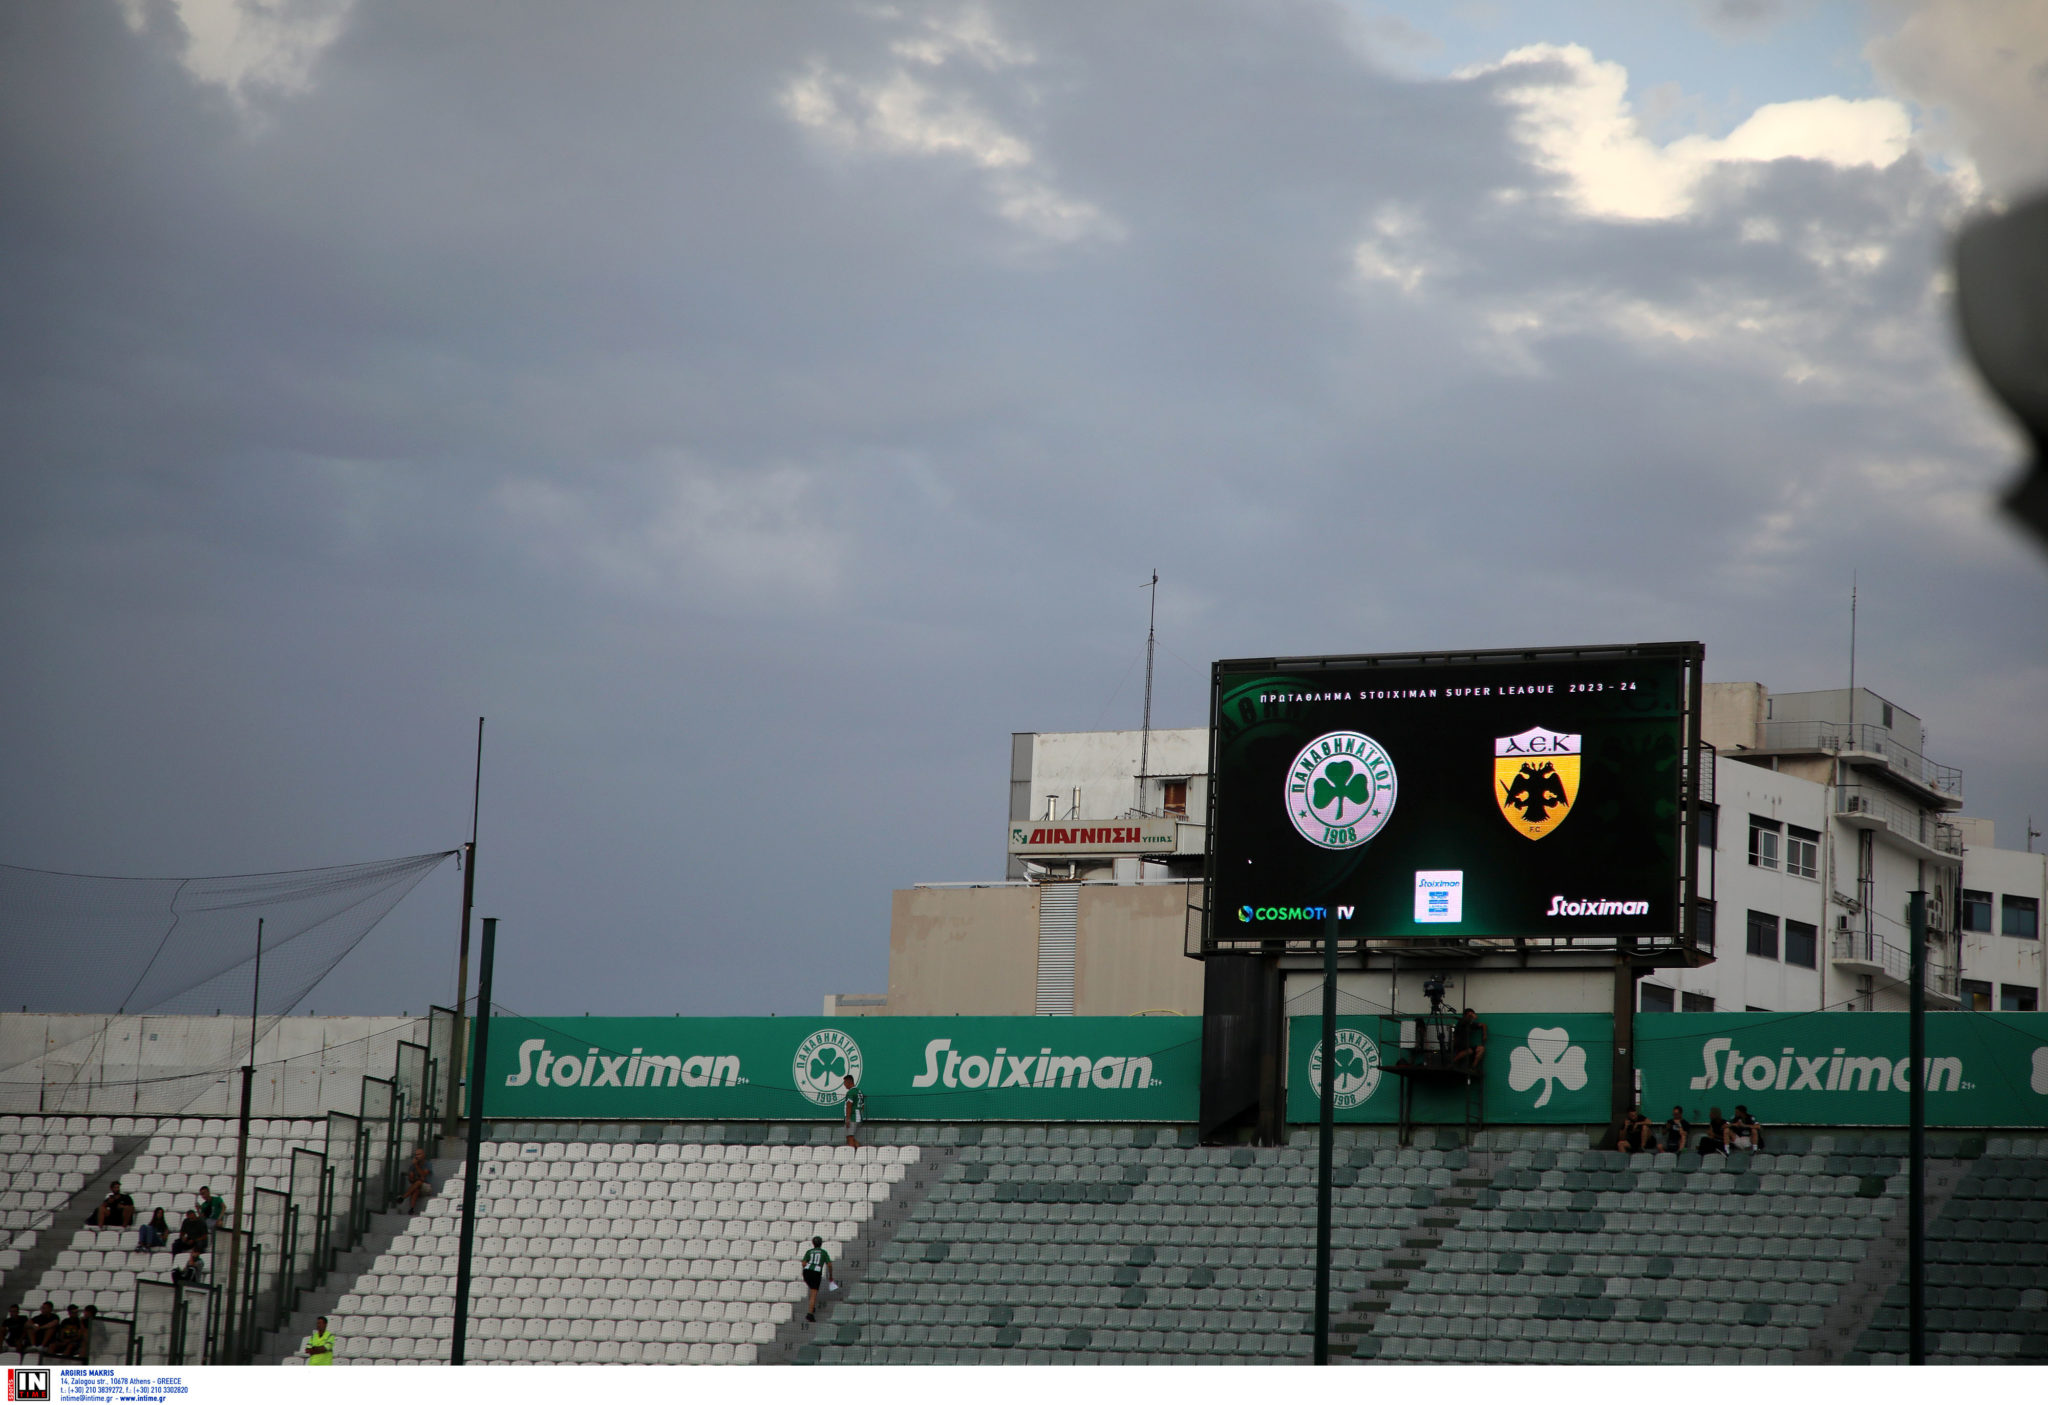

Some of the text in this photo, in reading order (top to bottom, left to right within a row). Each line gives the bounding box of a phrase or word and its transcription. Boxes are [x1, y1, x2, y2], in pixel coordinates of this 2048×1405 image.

[1260, 692, 1352, 703] ΠΡΩΤΑΘΛΗΜΑ
[1360, 689, 1437, 700] STOIXIMAN
[1445, 686, 1491, 697] SUPER
[1498, 684, 1554, 696] LEAGUE
[1029, 827, 1141, 845] ΔΙΑΓΝΩΣΗ
[1323, 827, 1357, 844] 1908
[1418, 878, 1460, 888] Stoiximan
[1546, 895, 1650, 916] Stoiximan
[505, 1038, 750, 1087] Stoiximan 21+
[912, 1038, 1163, 1089] Stoiximan 21+
[1690, 1037, 1976, 1093] Stoiximan 21+
[816, 1091, 838, 1103] 1908
[1334, 1094, 1357, 1106] 1908
[809, 1253, 821, 1265] 10
